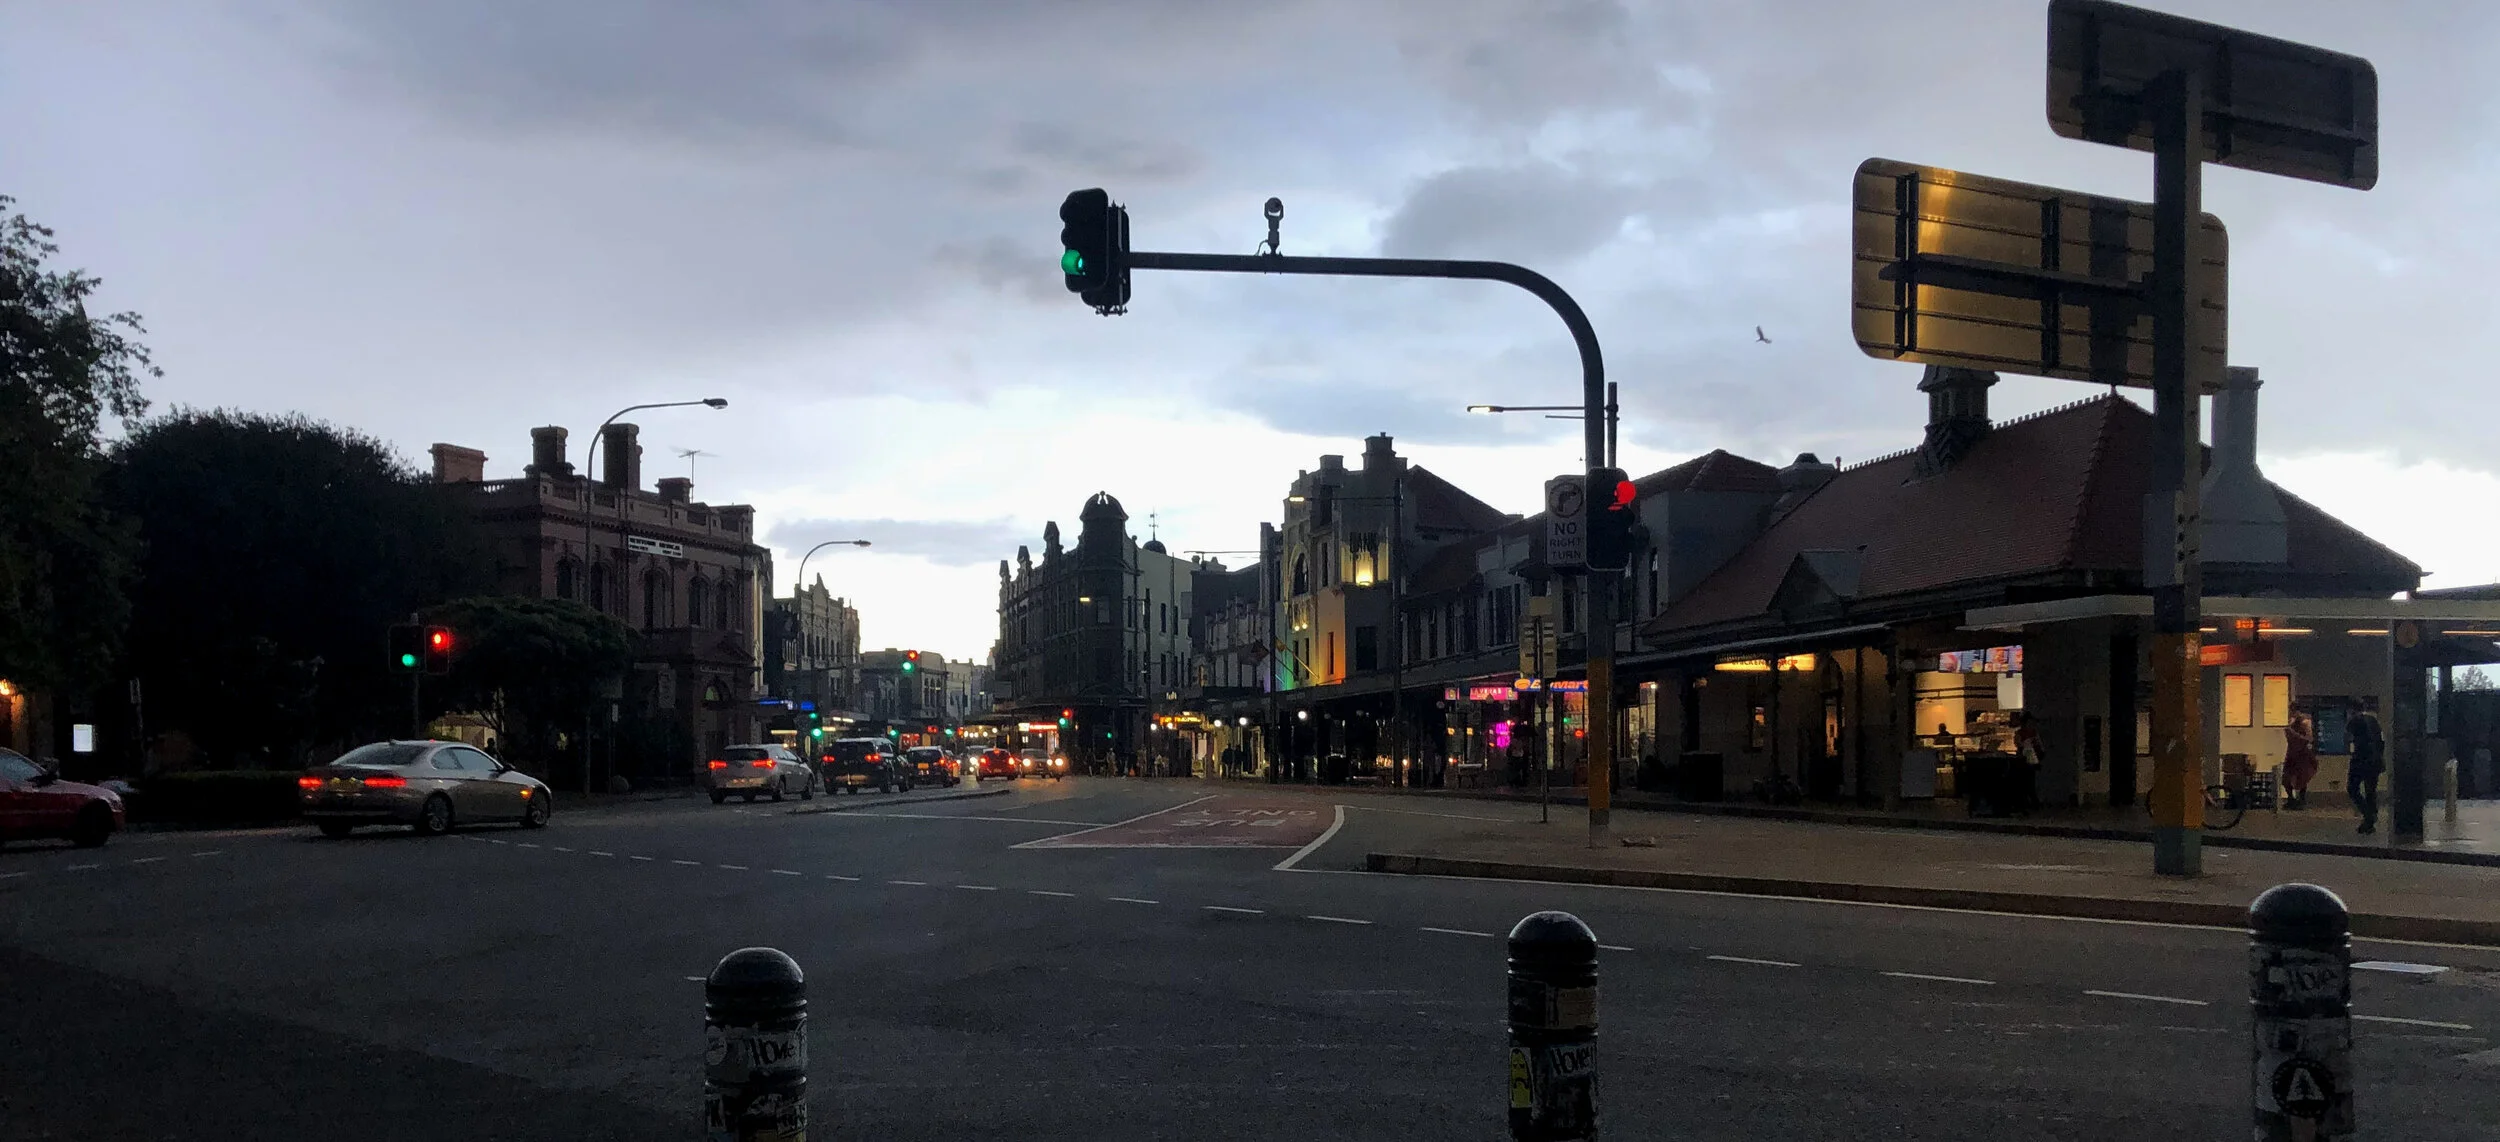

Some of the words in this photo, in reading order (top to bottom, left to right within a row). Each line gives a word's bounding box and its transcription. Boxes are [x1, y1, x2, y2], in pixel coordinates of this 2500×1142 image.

[1554, 521, 1577, 535] NO
[1549, 537, 1582, 547] RIGHT
[1551, 550, 1582, 559] TURN
